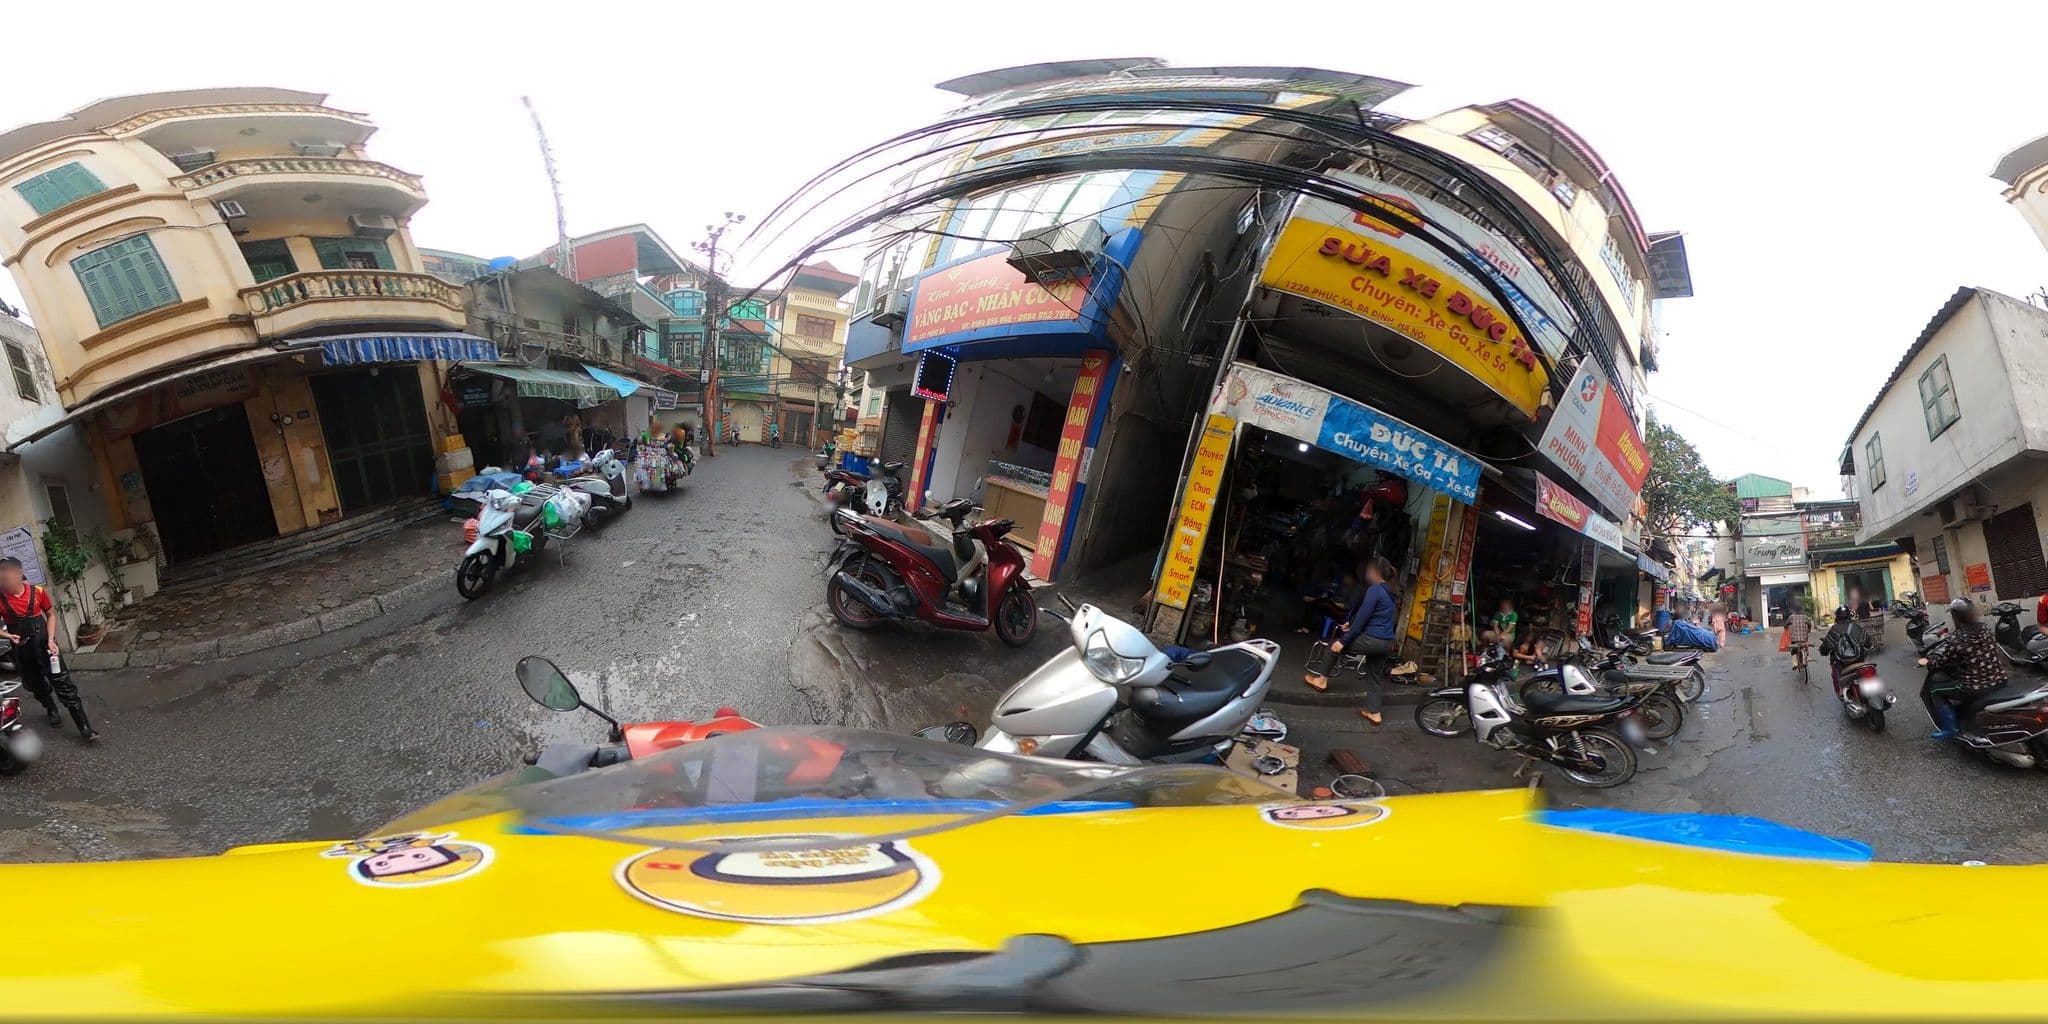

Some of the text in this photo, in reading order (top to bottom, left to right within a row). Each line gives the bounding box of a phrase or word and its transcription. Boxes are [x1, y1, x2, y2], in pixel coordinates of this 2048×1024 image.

[1477, 242, 1520, 278] Shell
[1399, 266, 1440, 299] XE
[943, 301, 969, 323] BẠC
[1351, 275, 1421, 318] Chuyên:
[1424, 308, 1446, 330] Xe
[1475, 339, 1491, 362] Xe
[1075, 376, 1096, 395] MUA
[1068, 403, 1088, 427] BÁN
[1256, 394, 1316, 416] ADVANCE
[1059, 437, 1081, 459] TRAO
[1369, 422, 1459, 477] ĐỨC TÁ
[1564, 425, 1588, 455] MINH
[1333, 432, 1389, 462] Chuyên
[1392, 453, 1410, 471] Xe
[1413, 464, 1432, 480] Ga
[1446, 477, 1461, 493] Xe
[1190, 499, 1206, 512] ECM
[1550, 494, 1580, 523] Havoline
[1167, 584, 1181, 599] Key
